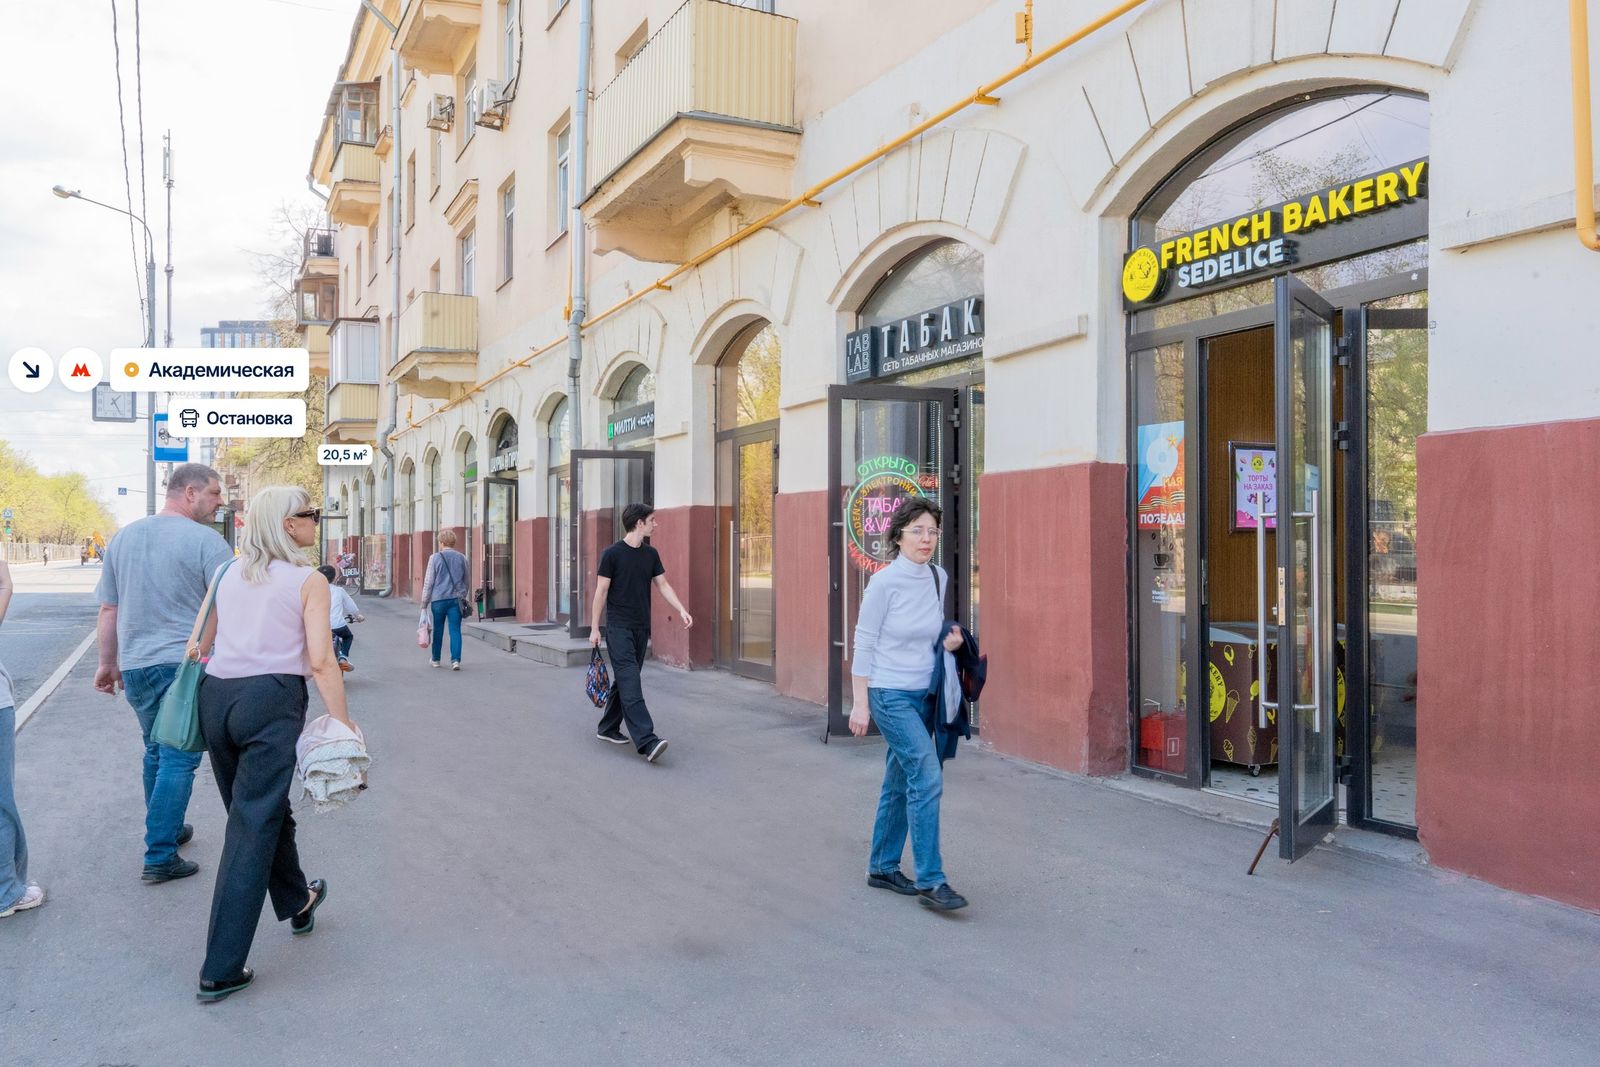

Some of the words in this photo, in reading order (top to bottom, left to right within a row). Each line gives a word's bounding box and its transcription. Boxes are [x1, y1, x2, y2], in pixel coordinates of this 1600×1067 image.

[1160, 210, 1272, 269] FRENCH
[1282, 162, 1425, 233] BAKERY
[1178, 238, 1284, 288] SEDELICE
[882, 298, 976, 357] ТАБАК
[848, 333, 870, 355] TAB
[883, 361, 899, 372] СЕТЬ
[901, 349, 939, 367] ТАБАЧНЫХ
[614, 417, 635, 436] МИЛТИ
[857, 456, 916, 476] ОТКРЫТО
[861, 476, 918, 497] ЭЛЕКТРОНКИ
[863, 497, 905, 513] ТАБА
[864, 517, 891, 533] &VA
